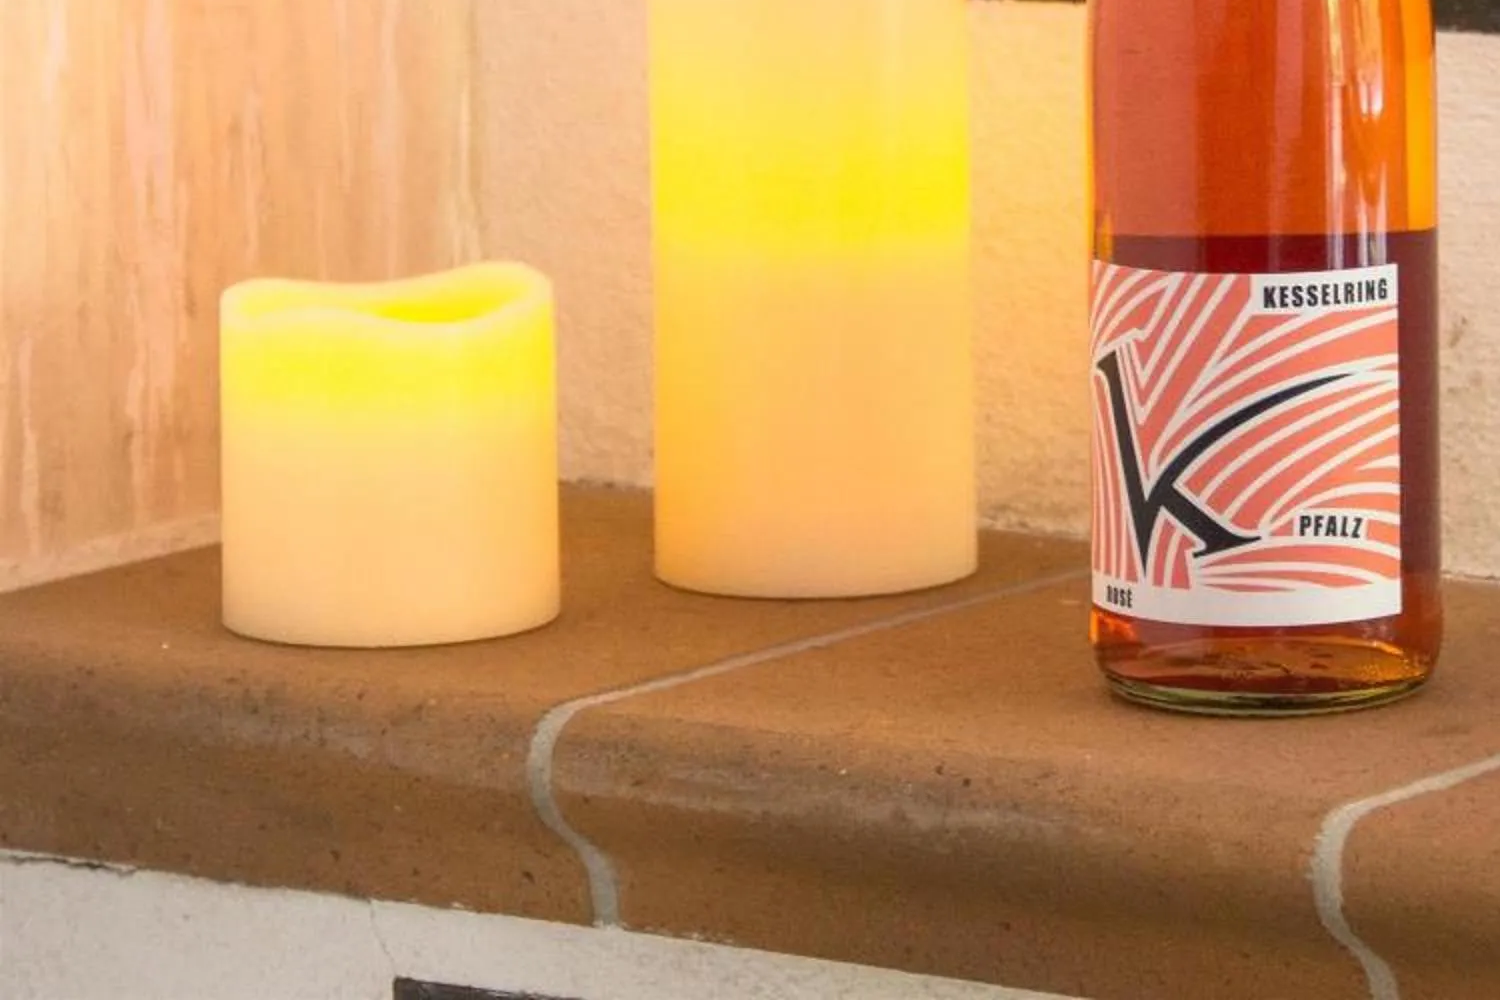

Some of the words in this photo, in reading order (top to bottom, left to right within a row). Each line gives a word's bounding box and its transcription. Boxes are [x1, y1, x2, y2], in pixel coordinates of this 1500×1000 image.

[1263, 278, 1388, 309] KESSELRING
[1096, 350, 1357, 577] K
[1299, 515, 1363, 539] PFALZ
